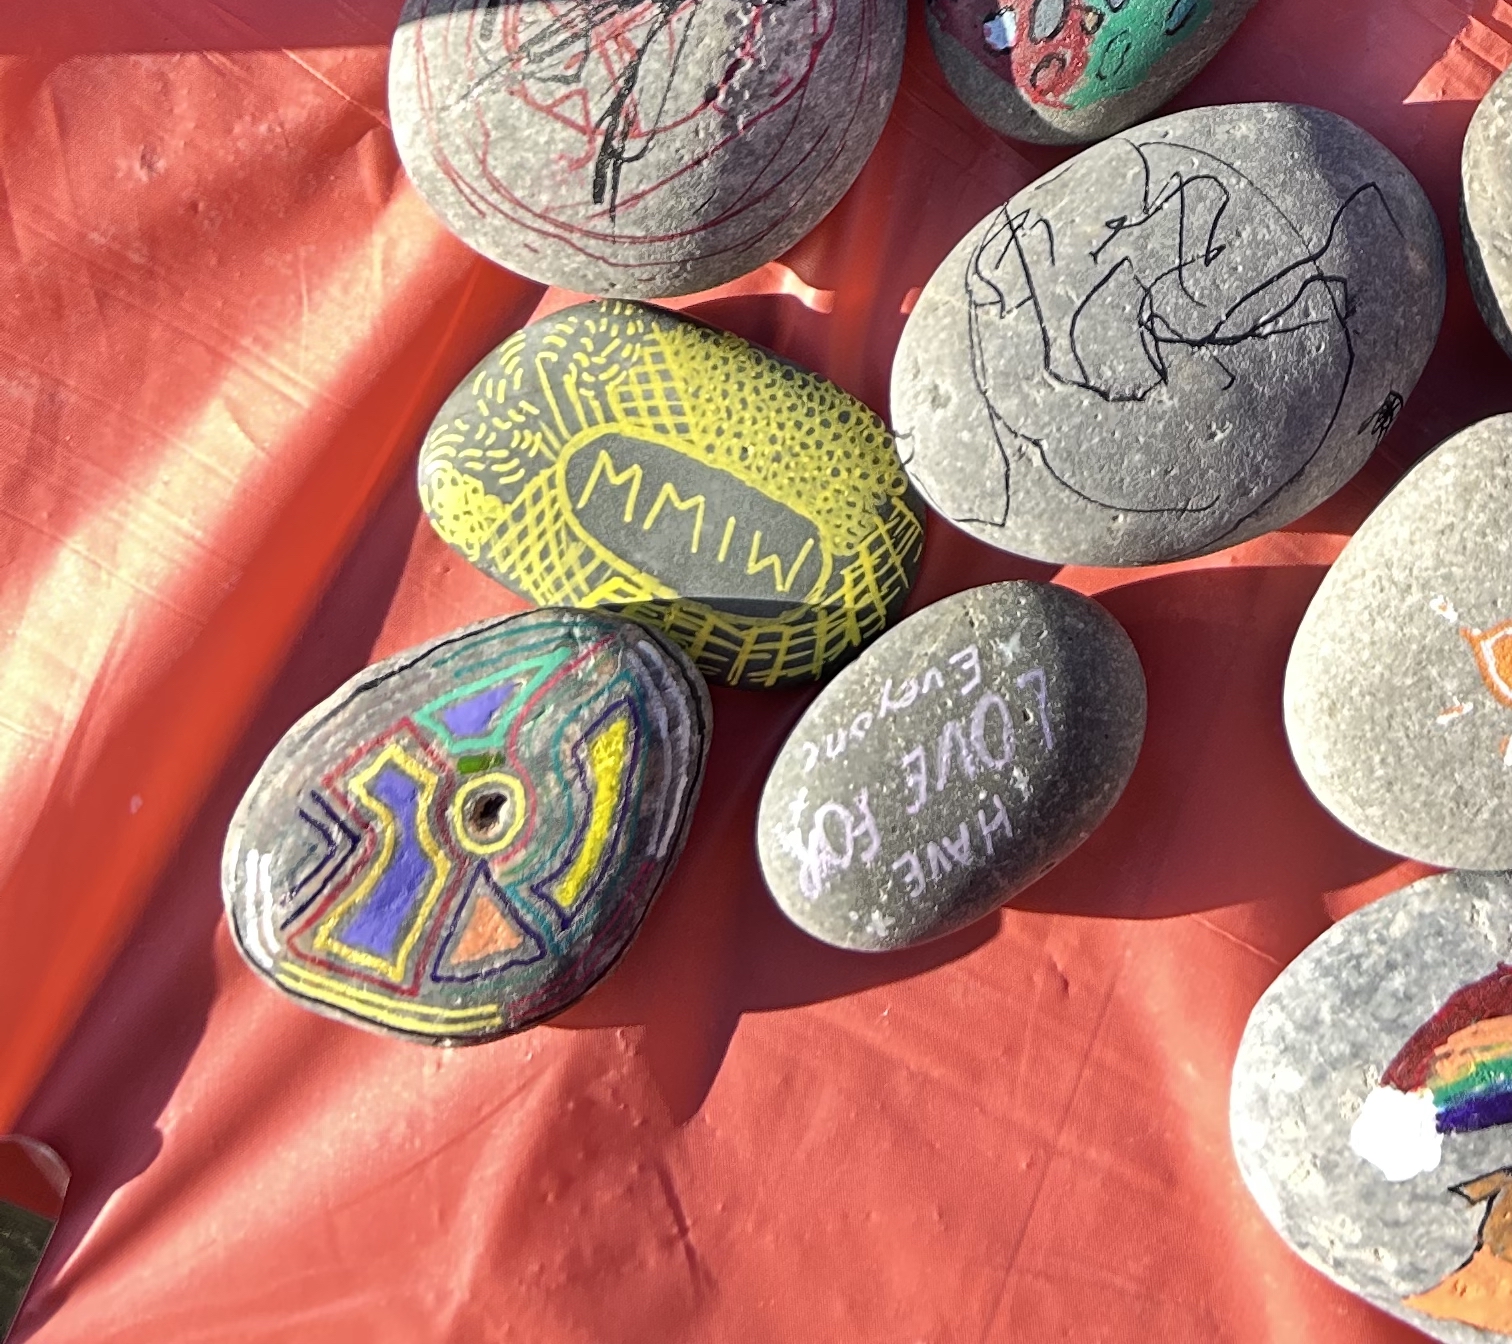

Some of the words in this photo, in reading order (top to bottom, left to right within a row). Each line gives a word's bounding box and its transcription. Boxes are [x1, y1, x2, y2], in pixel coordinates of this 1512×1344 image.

[574, 442, 815, 604] MMIW
[899, 666, 1054, 816] LOVE
[889, 796, 1014, 897] HAVE
